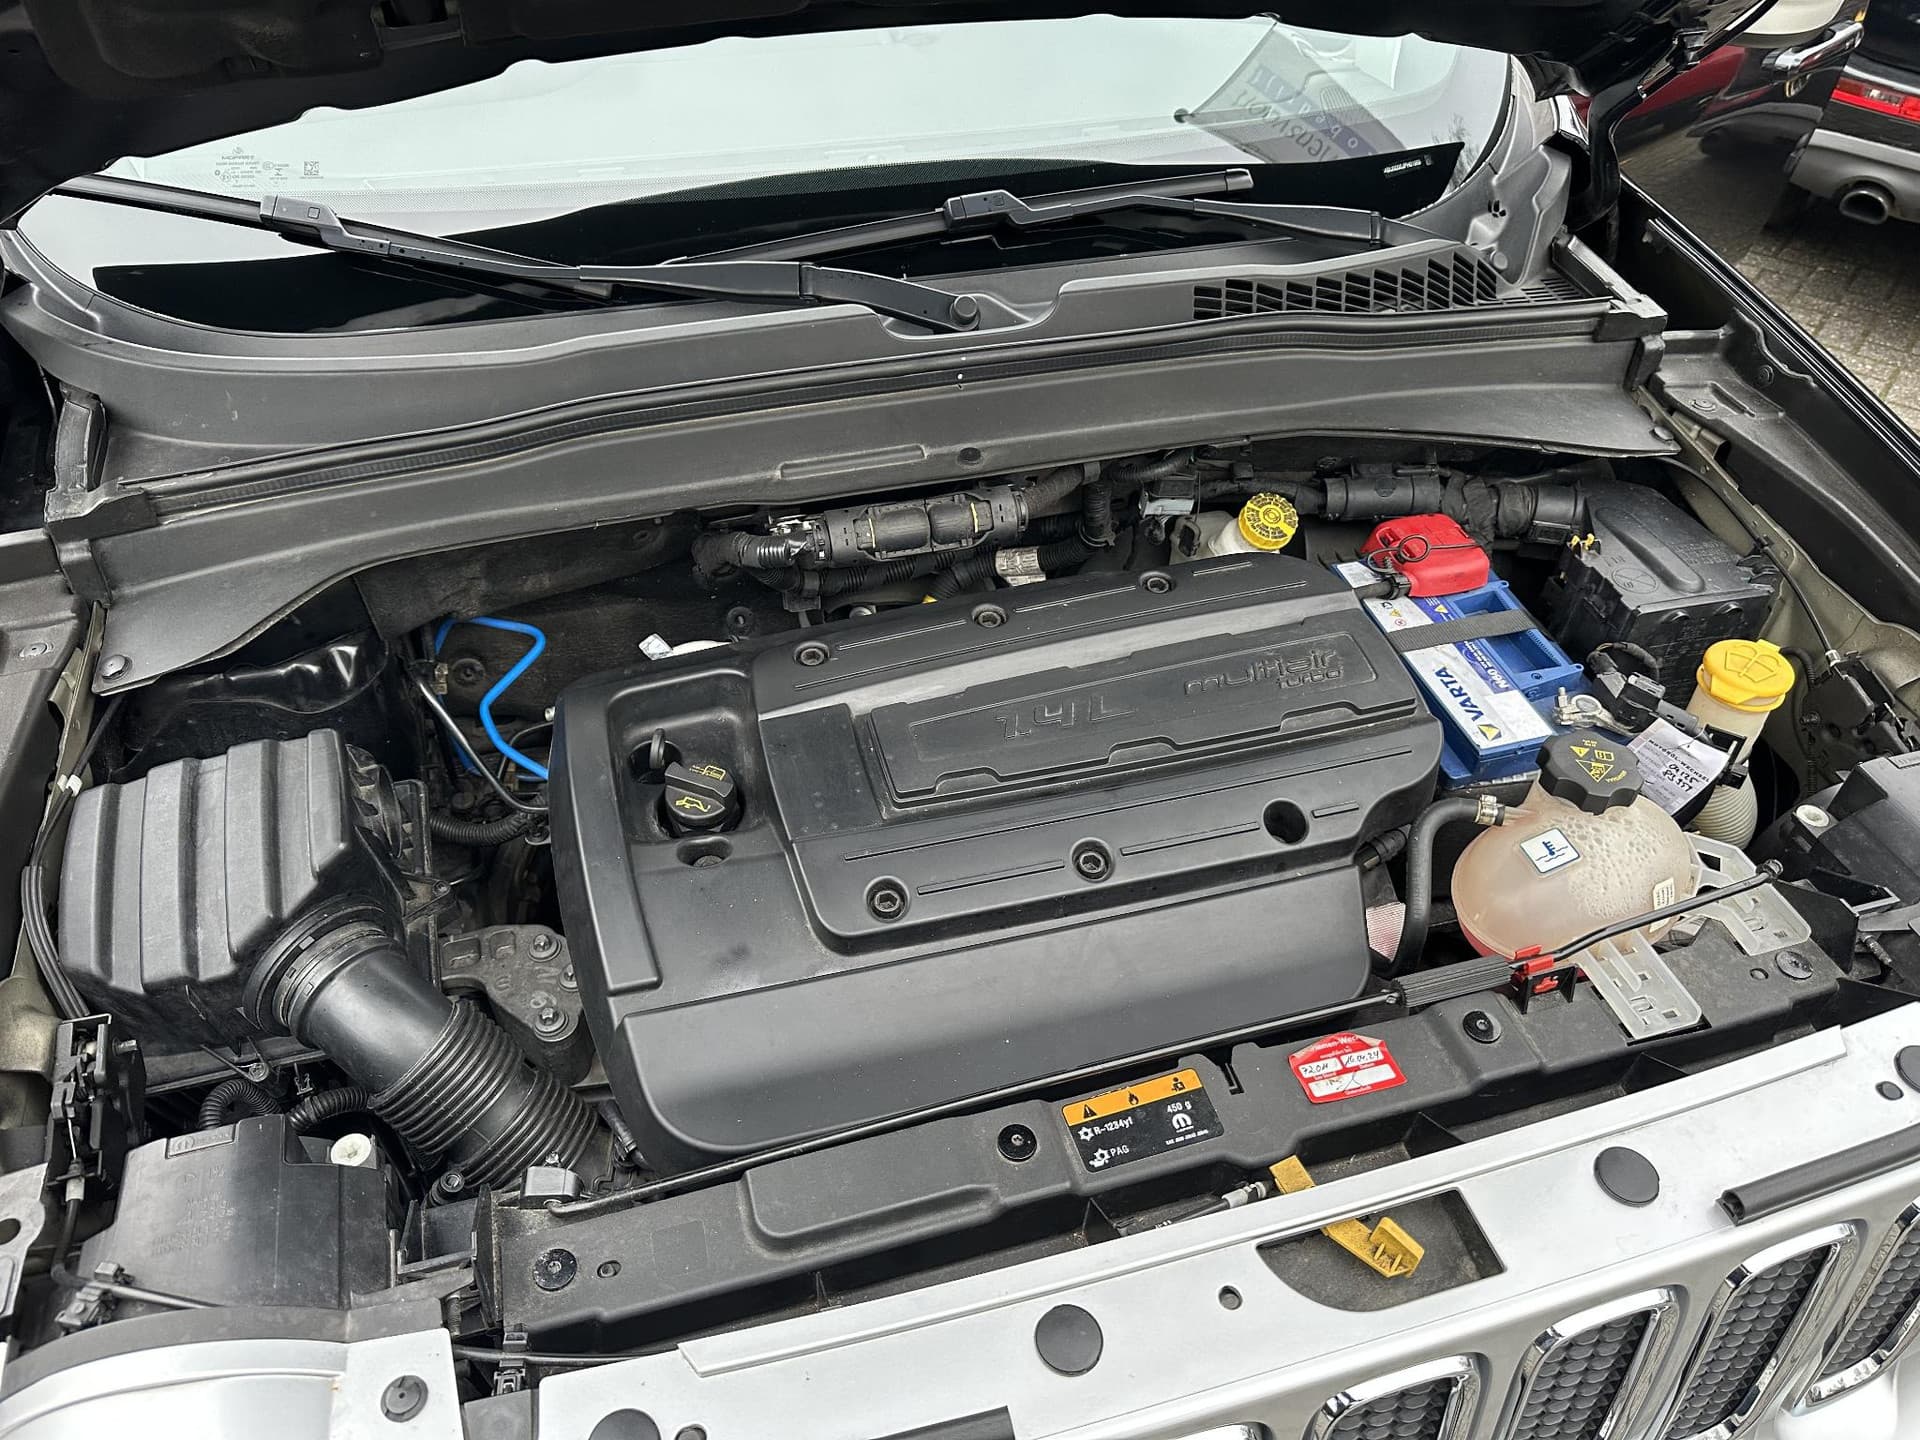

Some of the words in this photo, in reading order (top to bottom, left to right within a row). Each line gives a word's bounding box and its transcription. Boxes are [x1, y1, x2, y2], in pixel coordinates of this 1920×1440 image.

[1276, 666, 1344, 690] turbo
[1435, 666, 1484, 721] VARTA
[1167, 1102, 1184, 1114] 450
[1184, 1100, 1193, 1110] g
[1110, 1144, 1130, 1157] PAG
